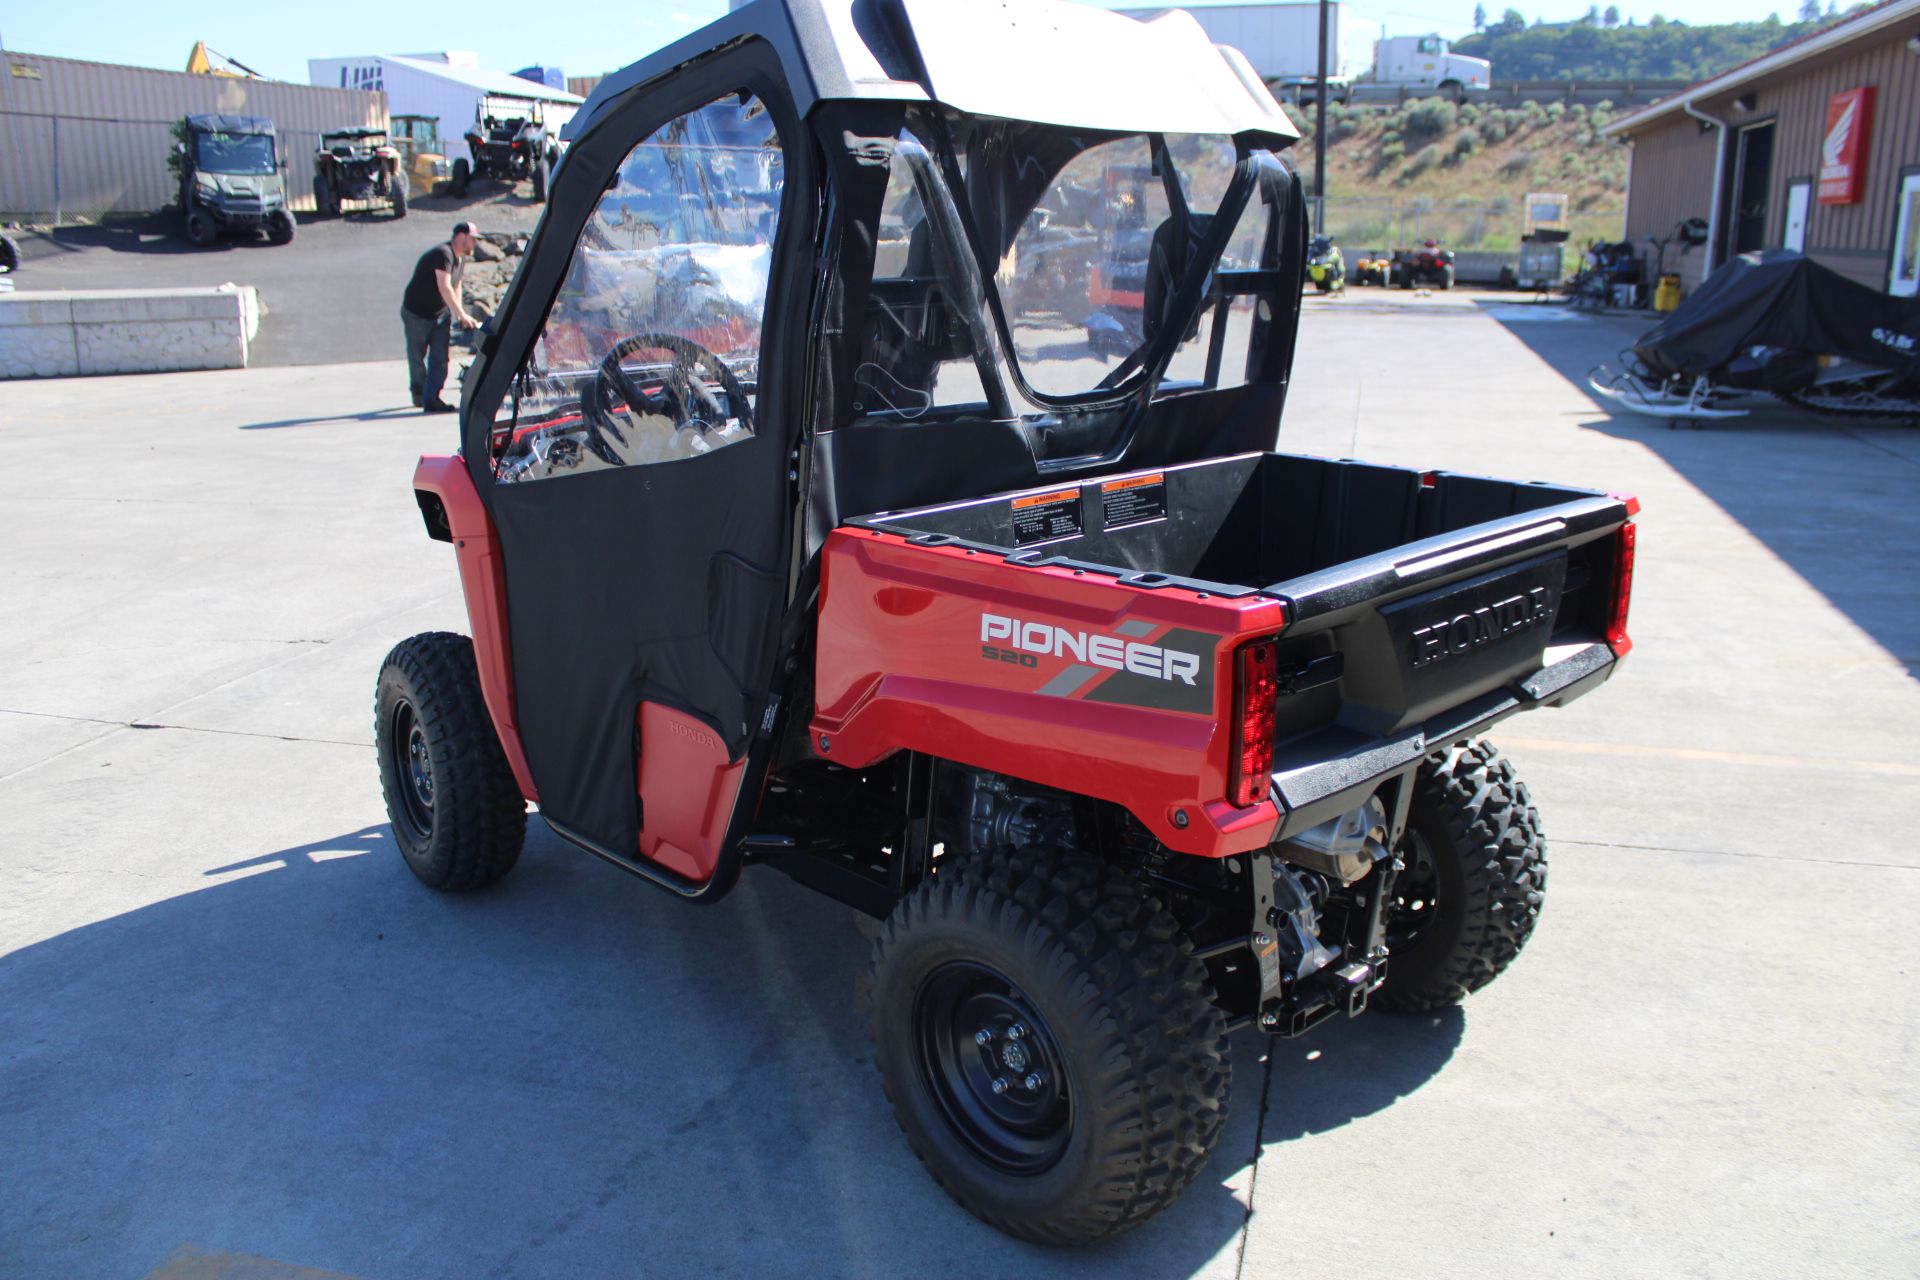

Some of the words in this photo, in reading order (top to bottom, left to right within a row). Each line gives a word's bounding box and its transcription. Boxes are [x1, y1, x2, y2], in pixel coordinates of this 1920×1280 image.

[1038, 493, 1061, 503] WARNING
[1411, 585, 1554, 669] HONDA
[980, 612, 1200, 687] PIONEER
[981, 645, 1038, 669] 520
[669, 720, 717, 751] HONDA
